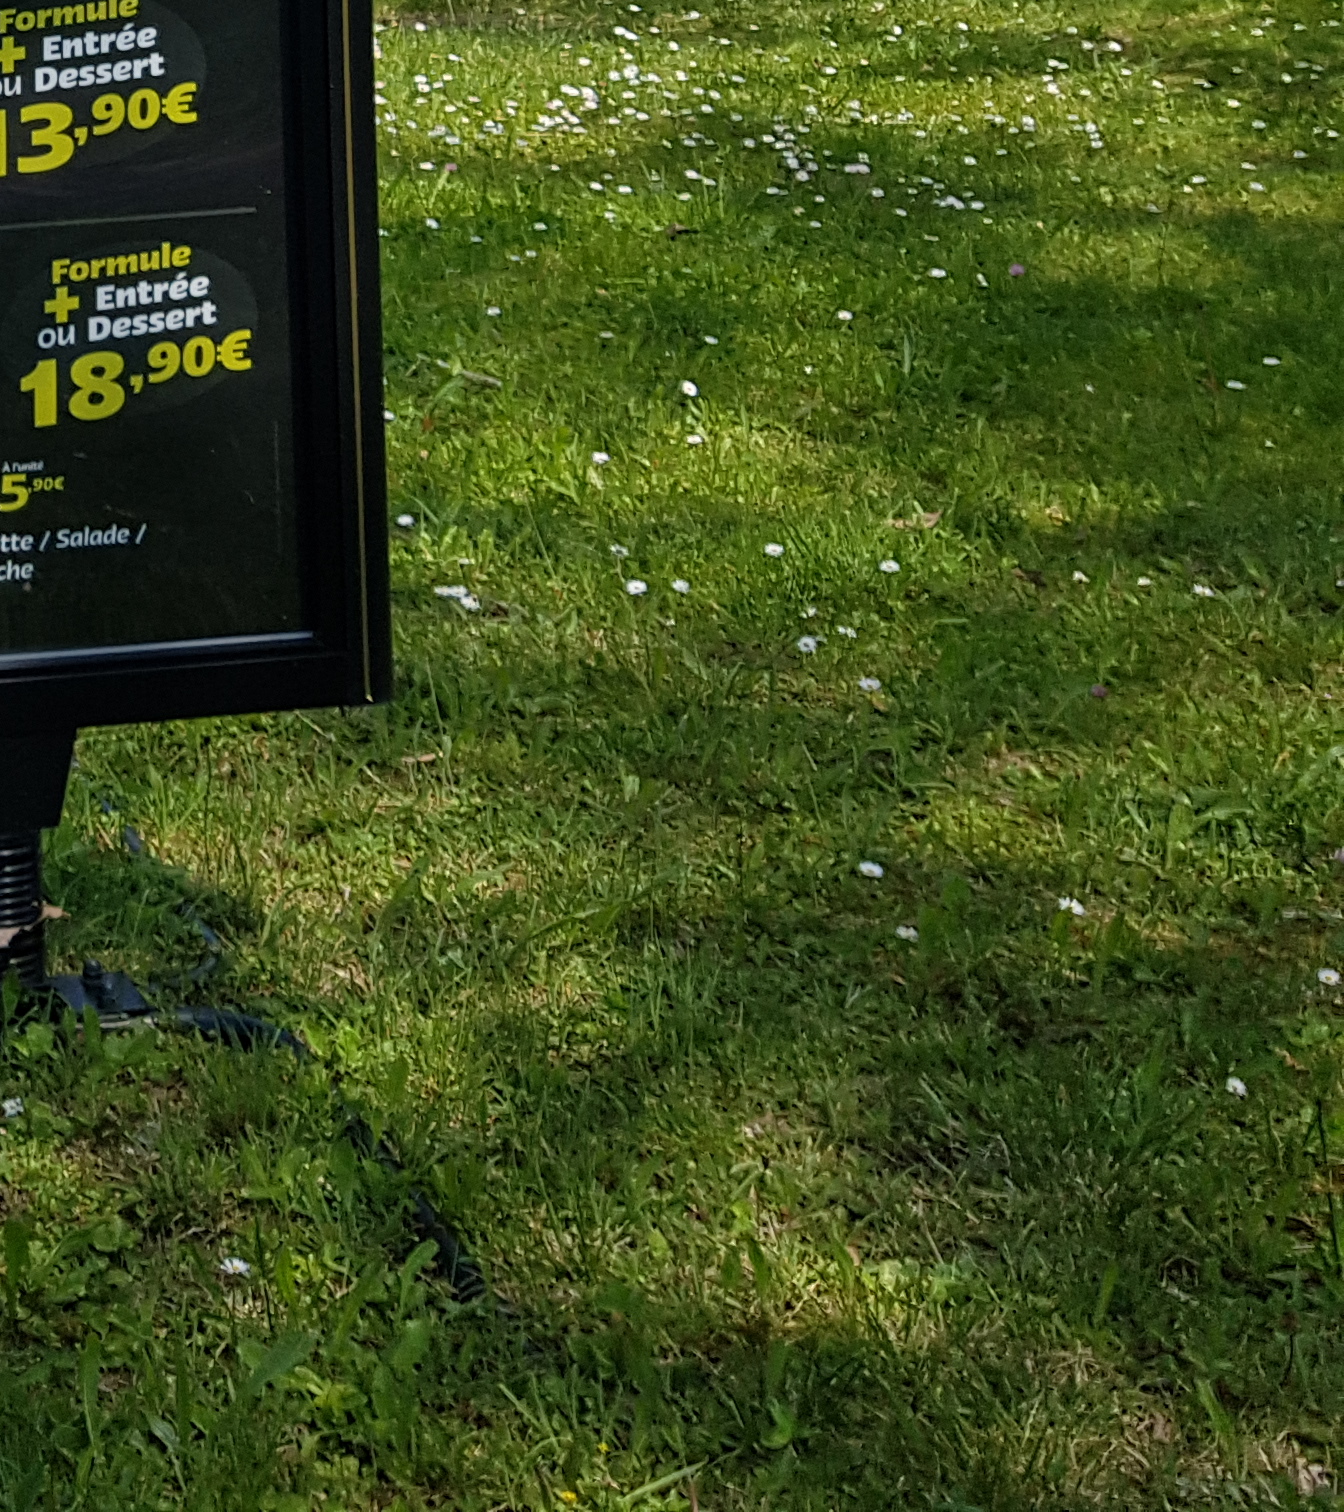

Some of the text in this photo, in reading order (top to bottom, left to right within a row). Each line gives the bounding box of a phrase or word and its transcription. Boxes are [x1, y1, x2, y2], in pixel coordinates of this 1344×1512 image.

[42, 22, 158, 62] Entrée
[34, 52, 165, 93] Dessert
[52, 241, 192, 285] Formule
[96, 271, 210, 311] Entrée
[37, 300, 217, 349] ou Dessert
[19, 328, 252, 428] 18,90€
[39, 530, 51, 552] /
[55, 523, 131, 550] Salade
[135, 522, 148, 545] /
